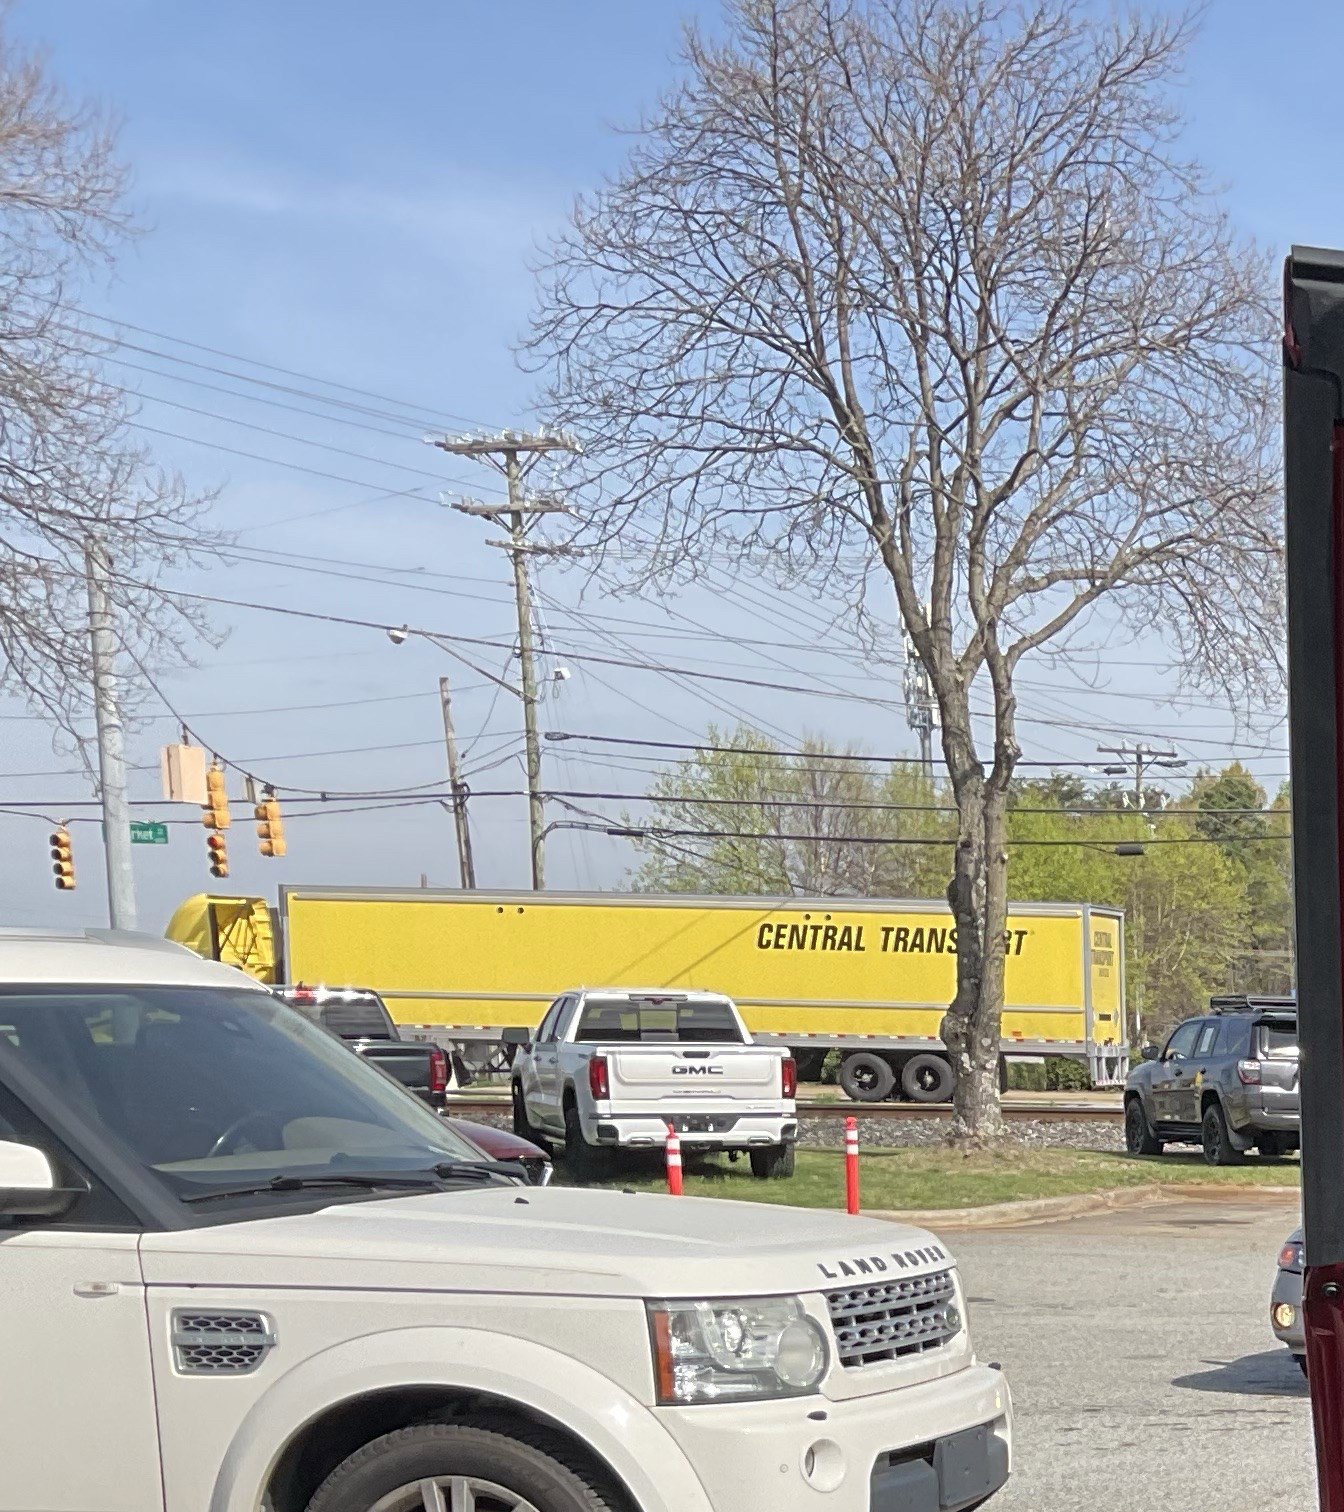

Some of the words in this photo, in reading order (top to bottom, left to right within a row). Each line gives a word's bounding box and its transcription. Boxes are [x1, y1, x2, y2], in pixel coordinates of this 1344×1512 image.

[757, 923, 866, 952] CENTRAL
[881, 926, 1028, 956] TRANSRT
[672, 1066, 724, 1075] GMC
[817, 1256, 888, 1279] LAND
[891, 1246, 946, 1269] ROVER
